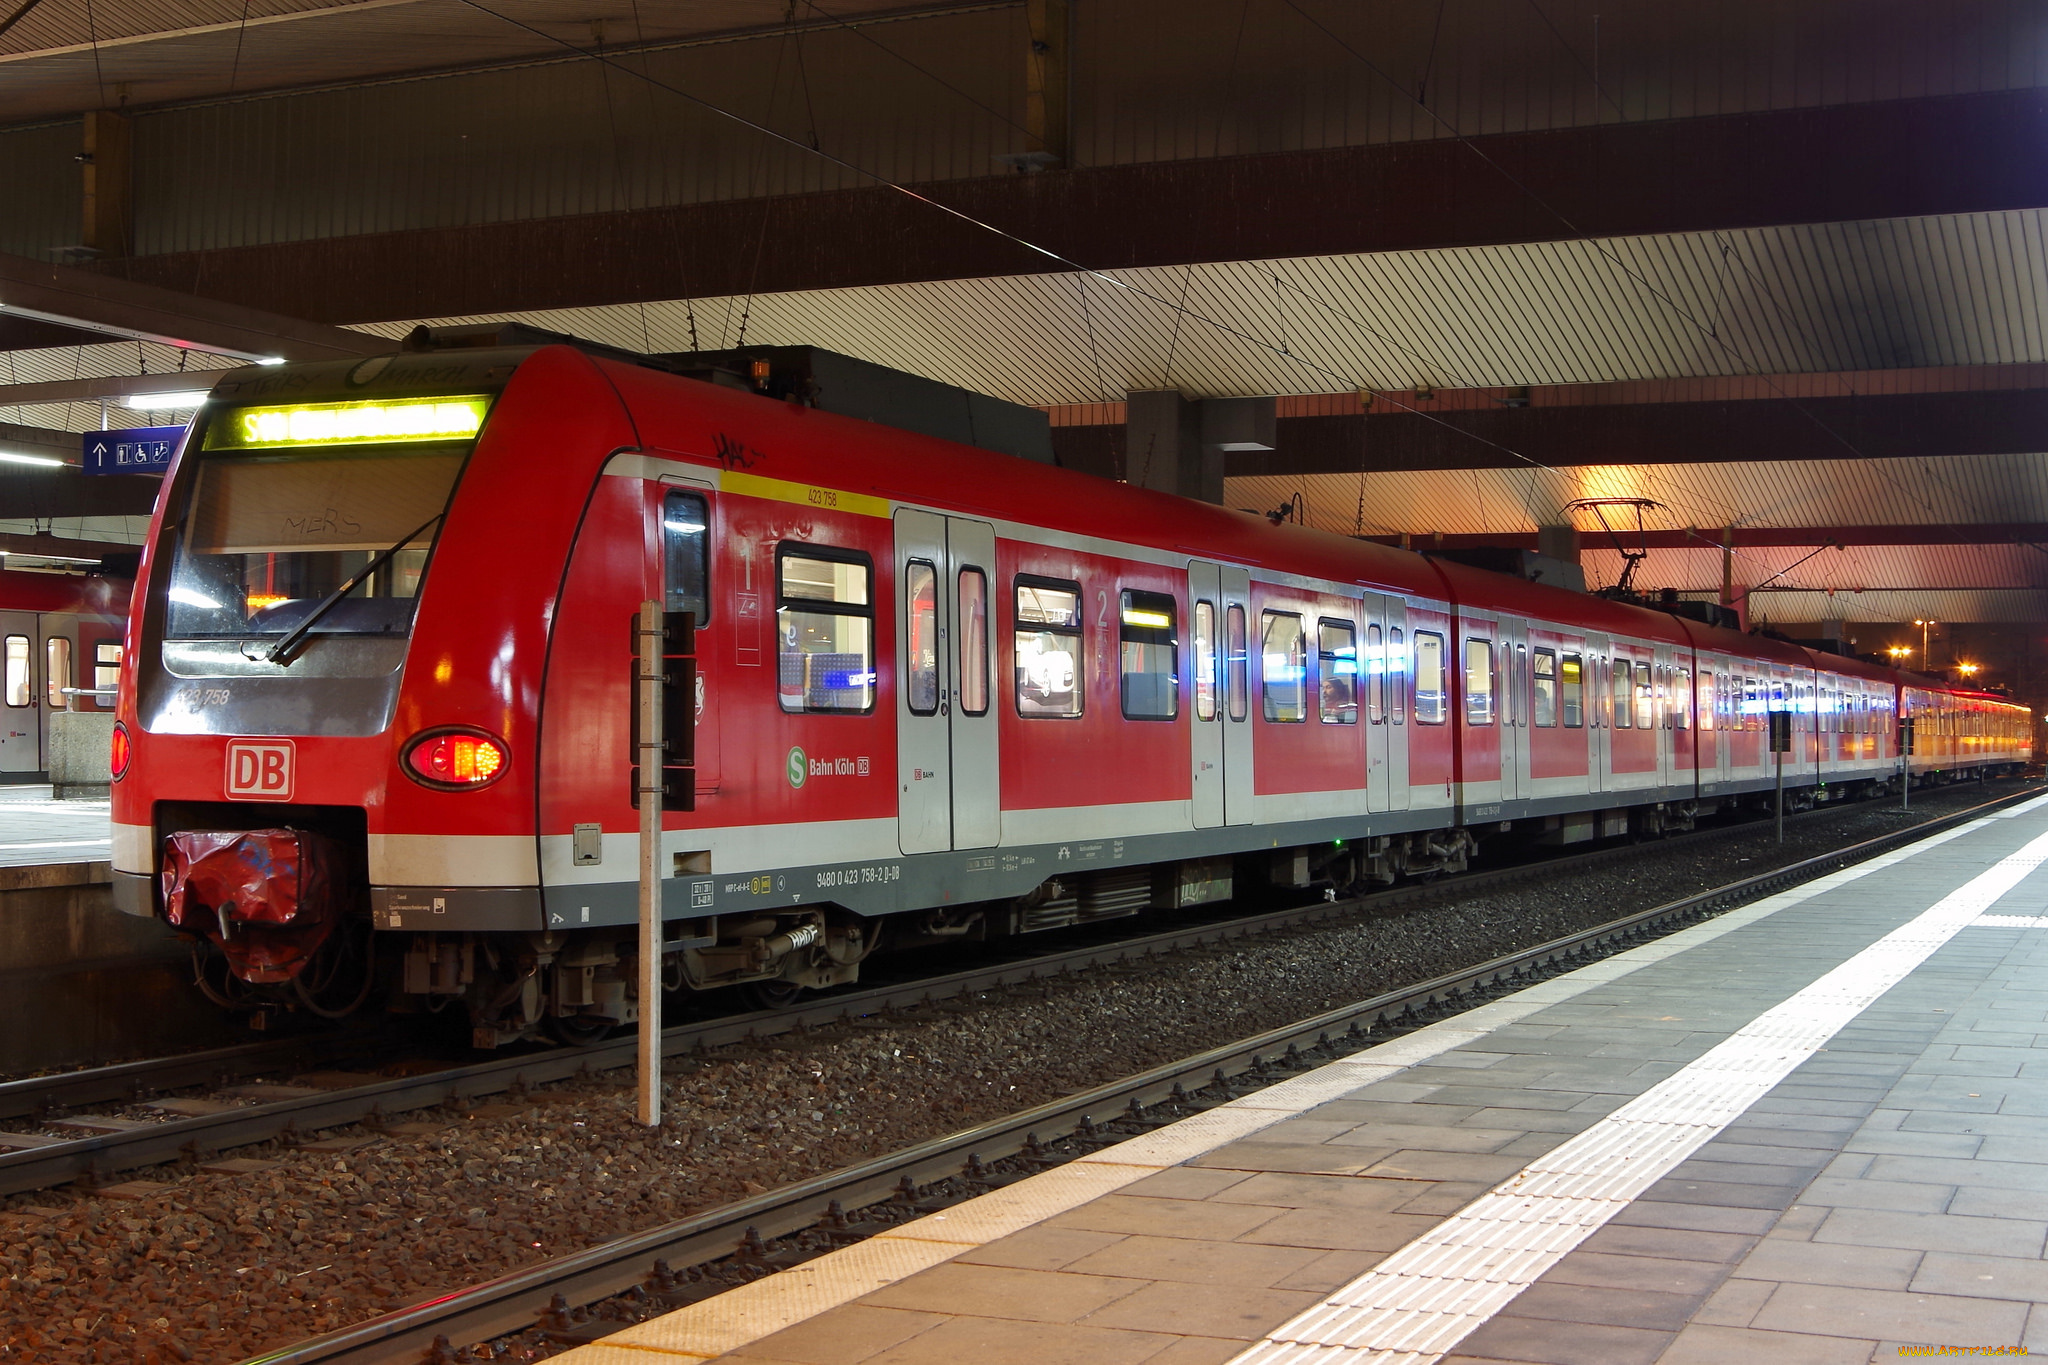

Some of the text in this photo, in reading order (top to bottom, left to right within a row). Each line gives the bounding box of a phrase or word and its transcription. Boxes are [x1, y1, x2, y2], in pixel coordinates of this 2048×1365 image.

[808, 488, 837, 507] 423 758
[1098, 590, 1108, 627] 2
[203, 688, 231, 706] 758
[234, 748, 286, 791] DB
[790, 751, 869, 784] S Bahn Köln DB
[816, 872, 836, 888] 9480
[844, 869, 859, 885] 423
